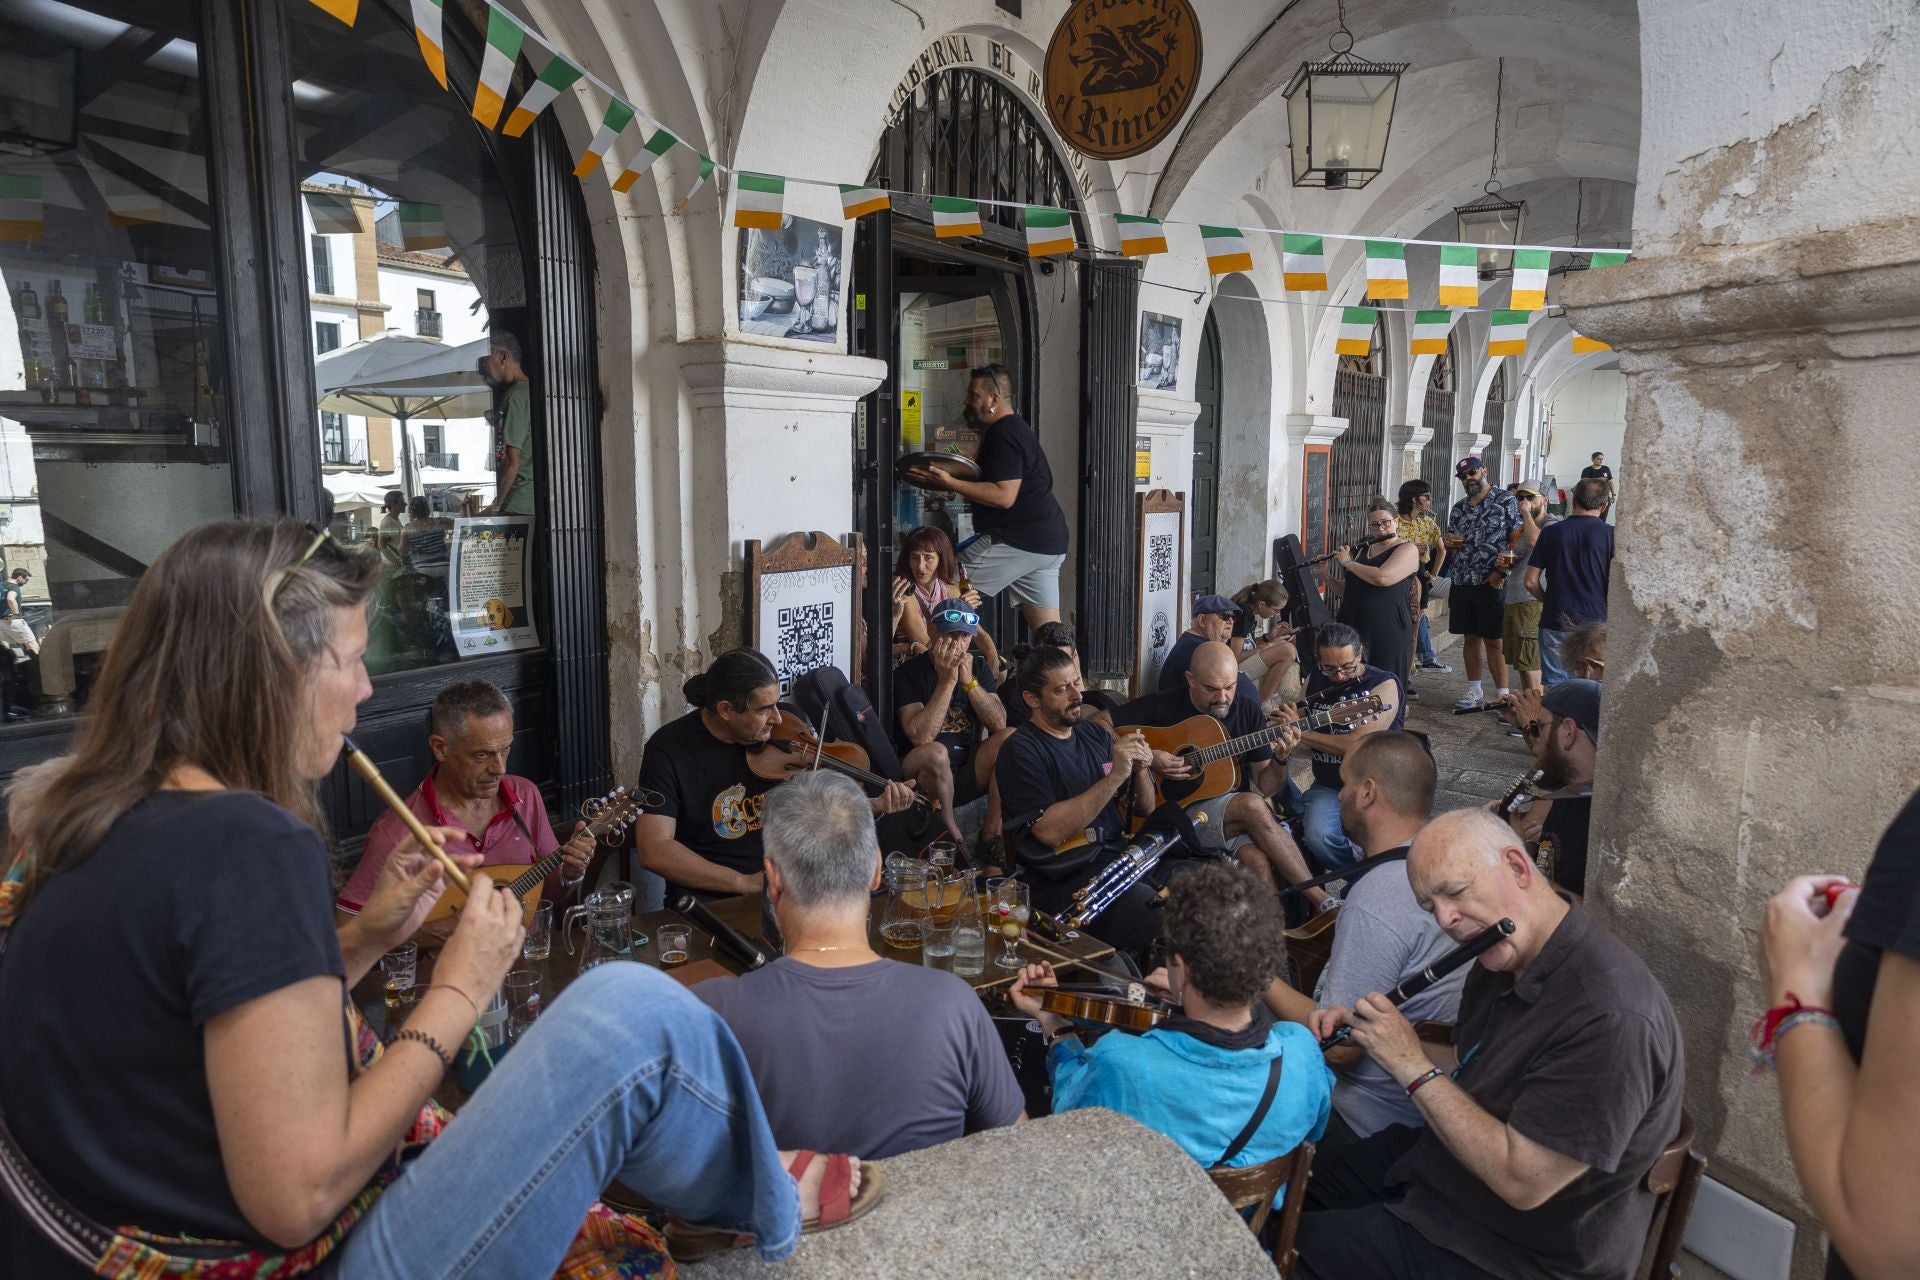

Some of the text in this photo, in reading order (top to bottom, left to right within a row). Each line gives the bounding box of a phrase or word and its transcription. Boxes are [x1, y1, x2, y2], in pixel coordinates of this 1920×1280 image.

[883, 34, 975, 129] TABERNA
[988, 40, 1016, 80] EL
[1073, 74, 1186, 147] Rincón
